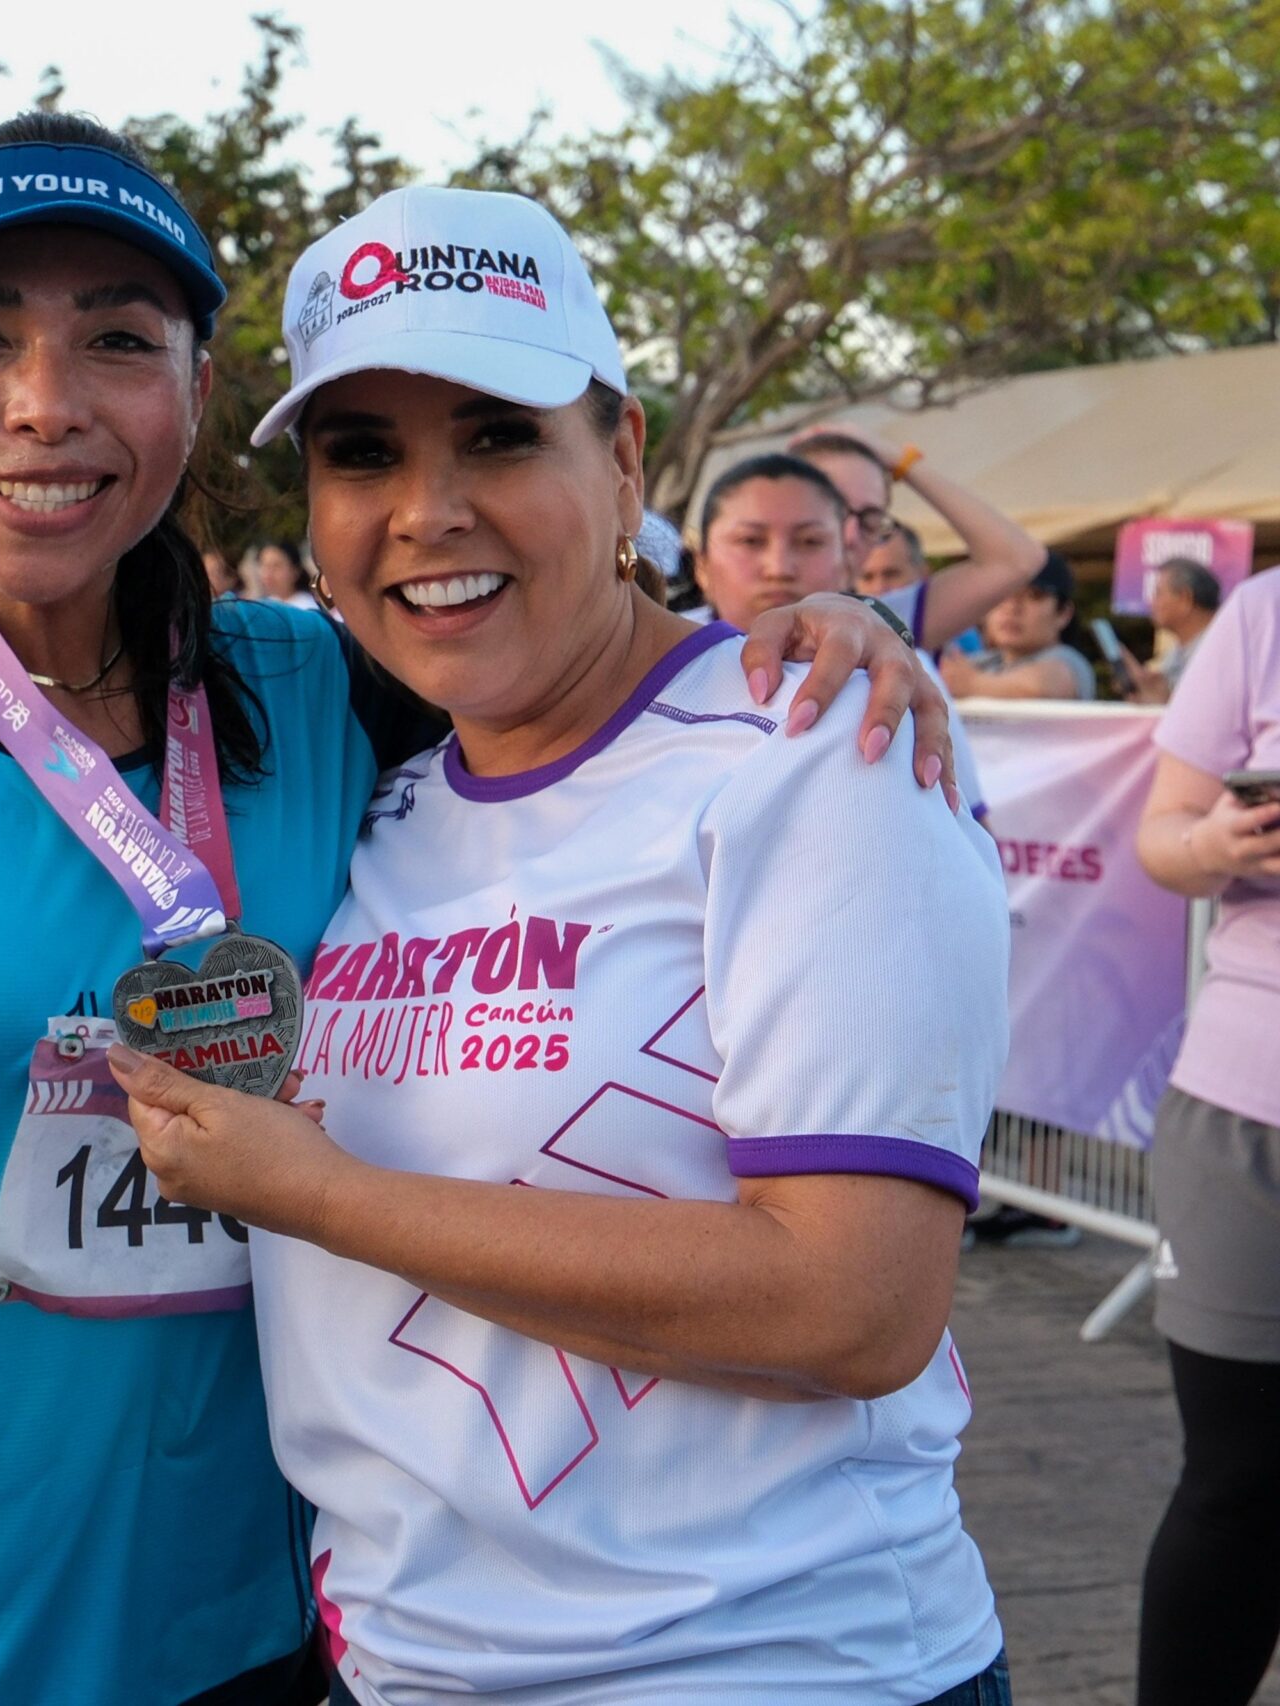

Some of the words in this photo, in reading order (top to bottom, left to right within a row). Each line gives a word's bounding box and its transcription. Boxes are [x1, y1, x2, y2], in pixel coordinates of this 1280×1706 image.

[11, 173, 110, 199] YOUR
[118, 187, 186, 246] MIND
[395, 270, 484, 294] ROO
[103, 785, 126, 812] 2025
[121, 808, 161, 856] MUJER
[156, 845, 177, 871] LA
[169, 861, 192, 885] DE
[464, 999, 574, 1027] Cancún
[298, 1007, 343, 1076] LA
[342, 1000, 454, 1085] MUJER
[459, 1033, 570, 1072] 2025
